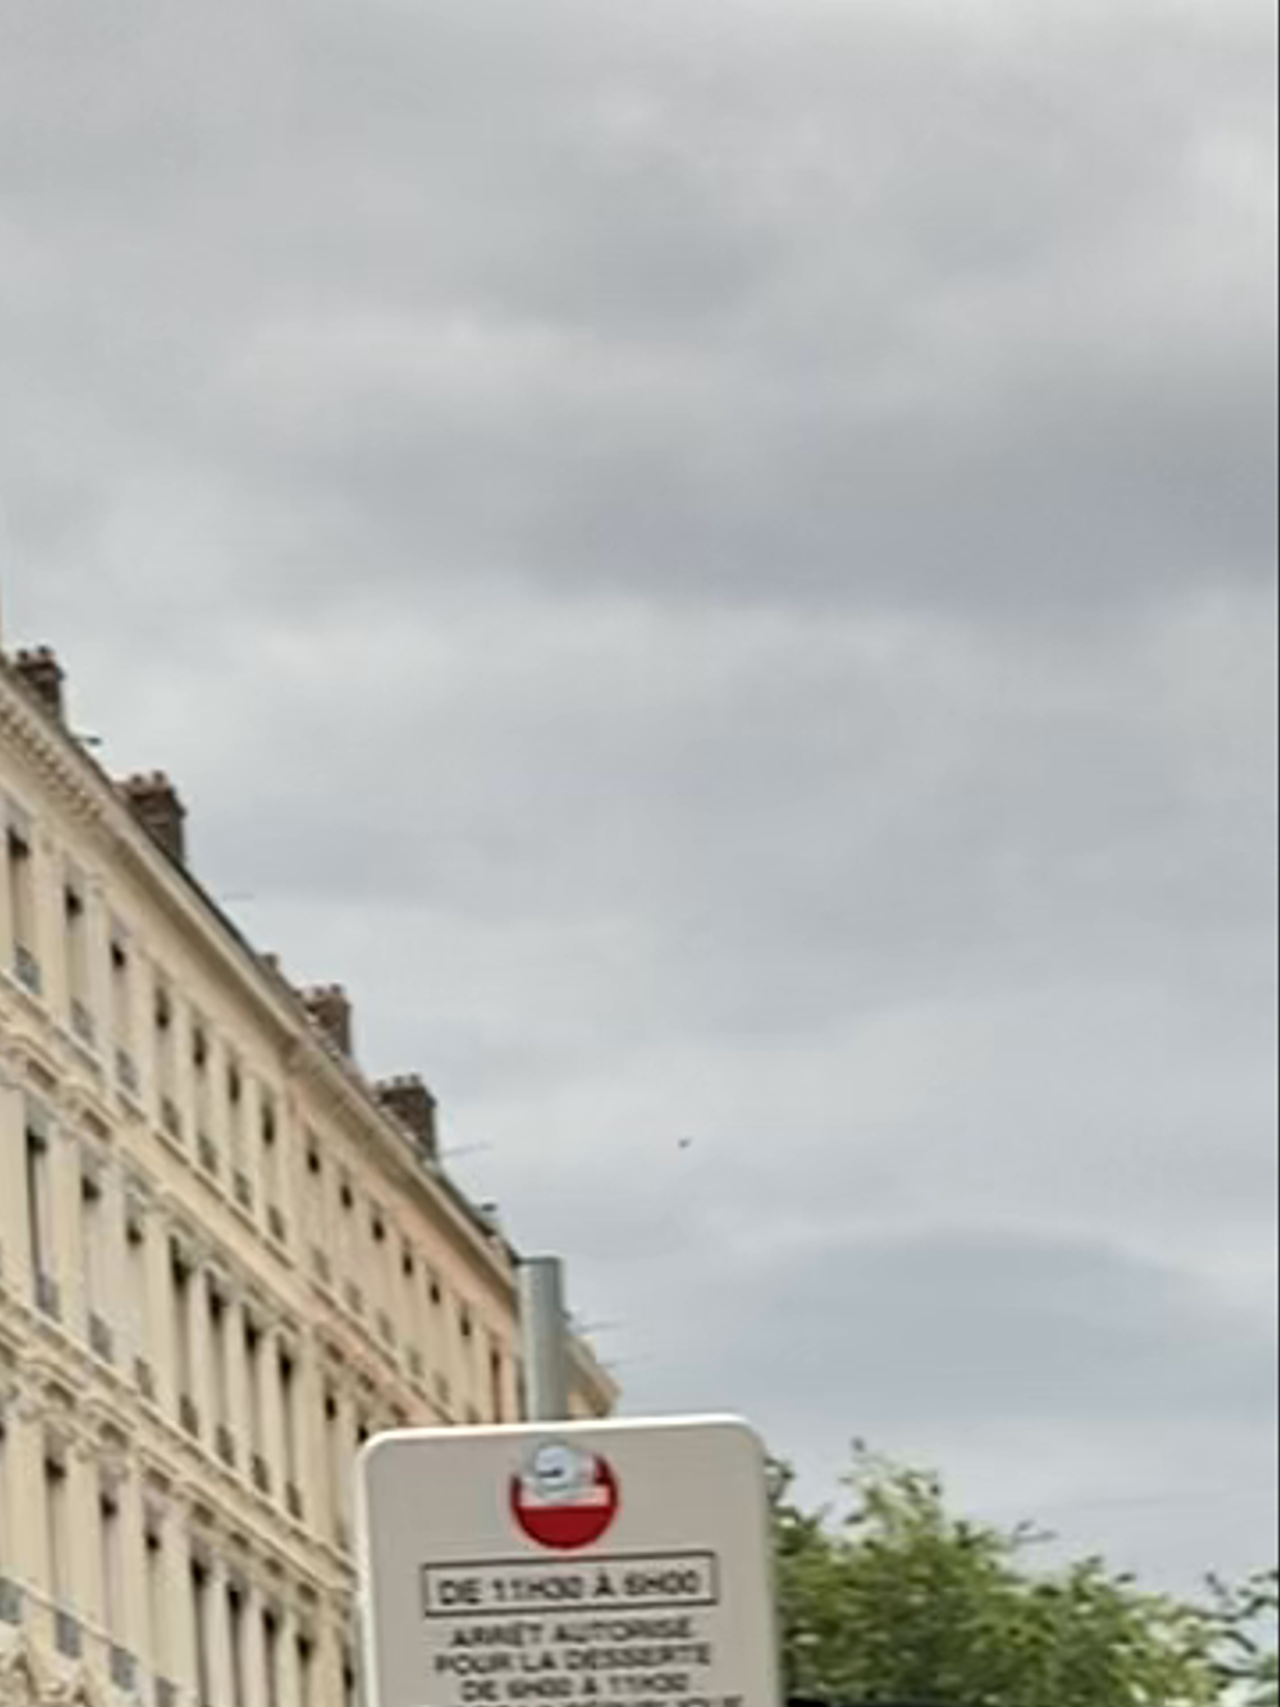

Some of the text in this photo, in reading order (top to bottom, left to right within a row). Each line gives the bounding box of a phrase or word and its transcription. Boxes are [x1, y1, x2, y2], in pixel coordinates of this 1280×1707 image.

[438, 1577, 482, 1605] DE
[434, 1643, 712, 1677] POUR LA DESSERTE
[460, 1679, 498, 1703] DE
